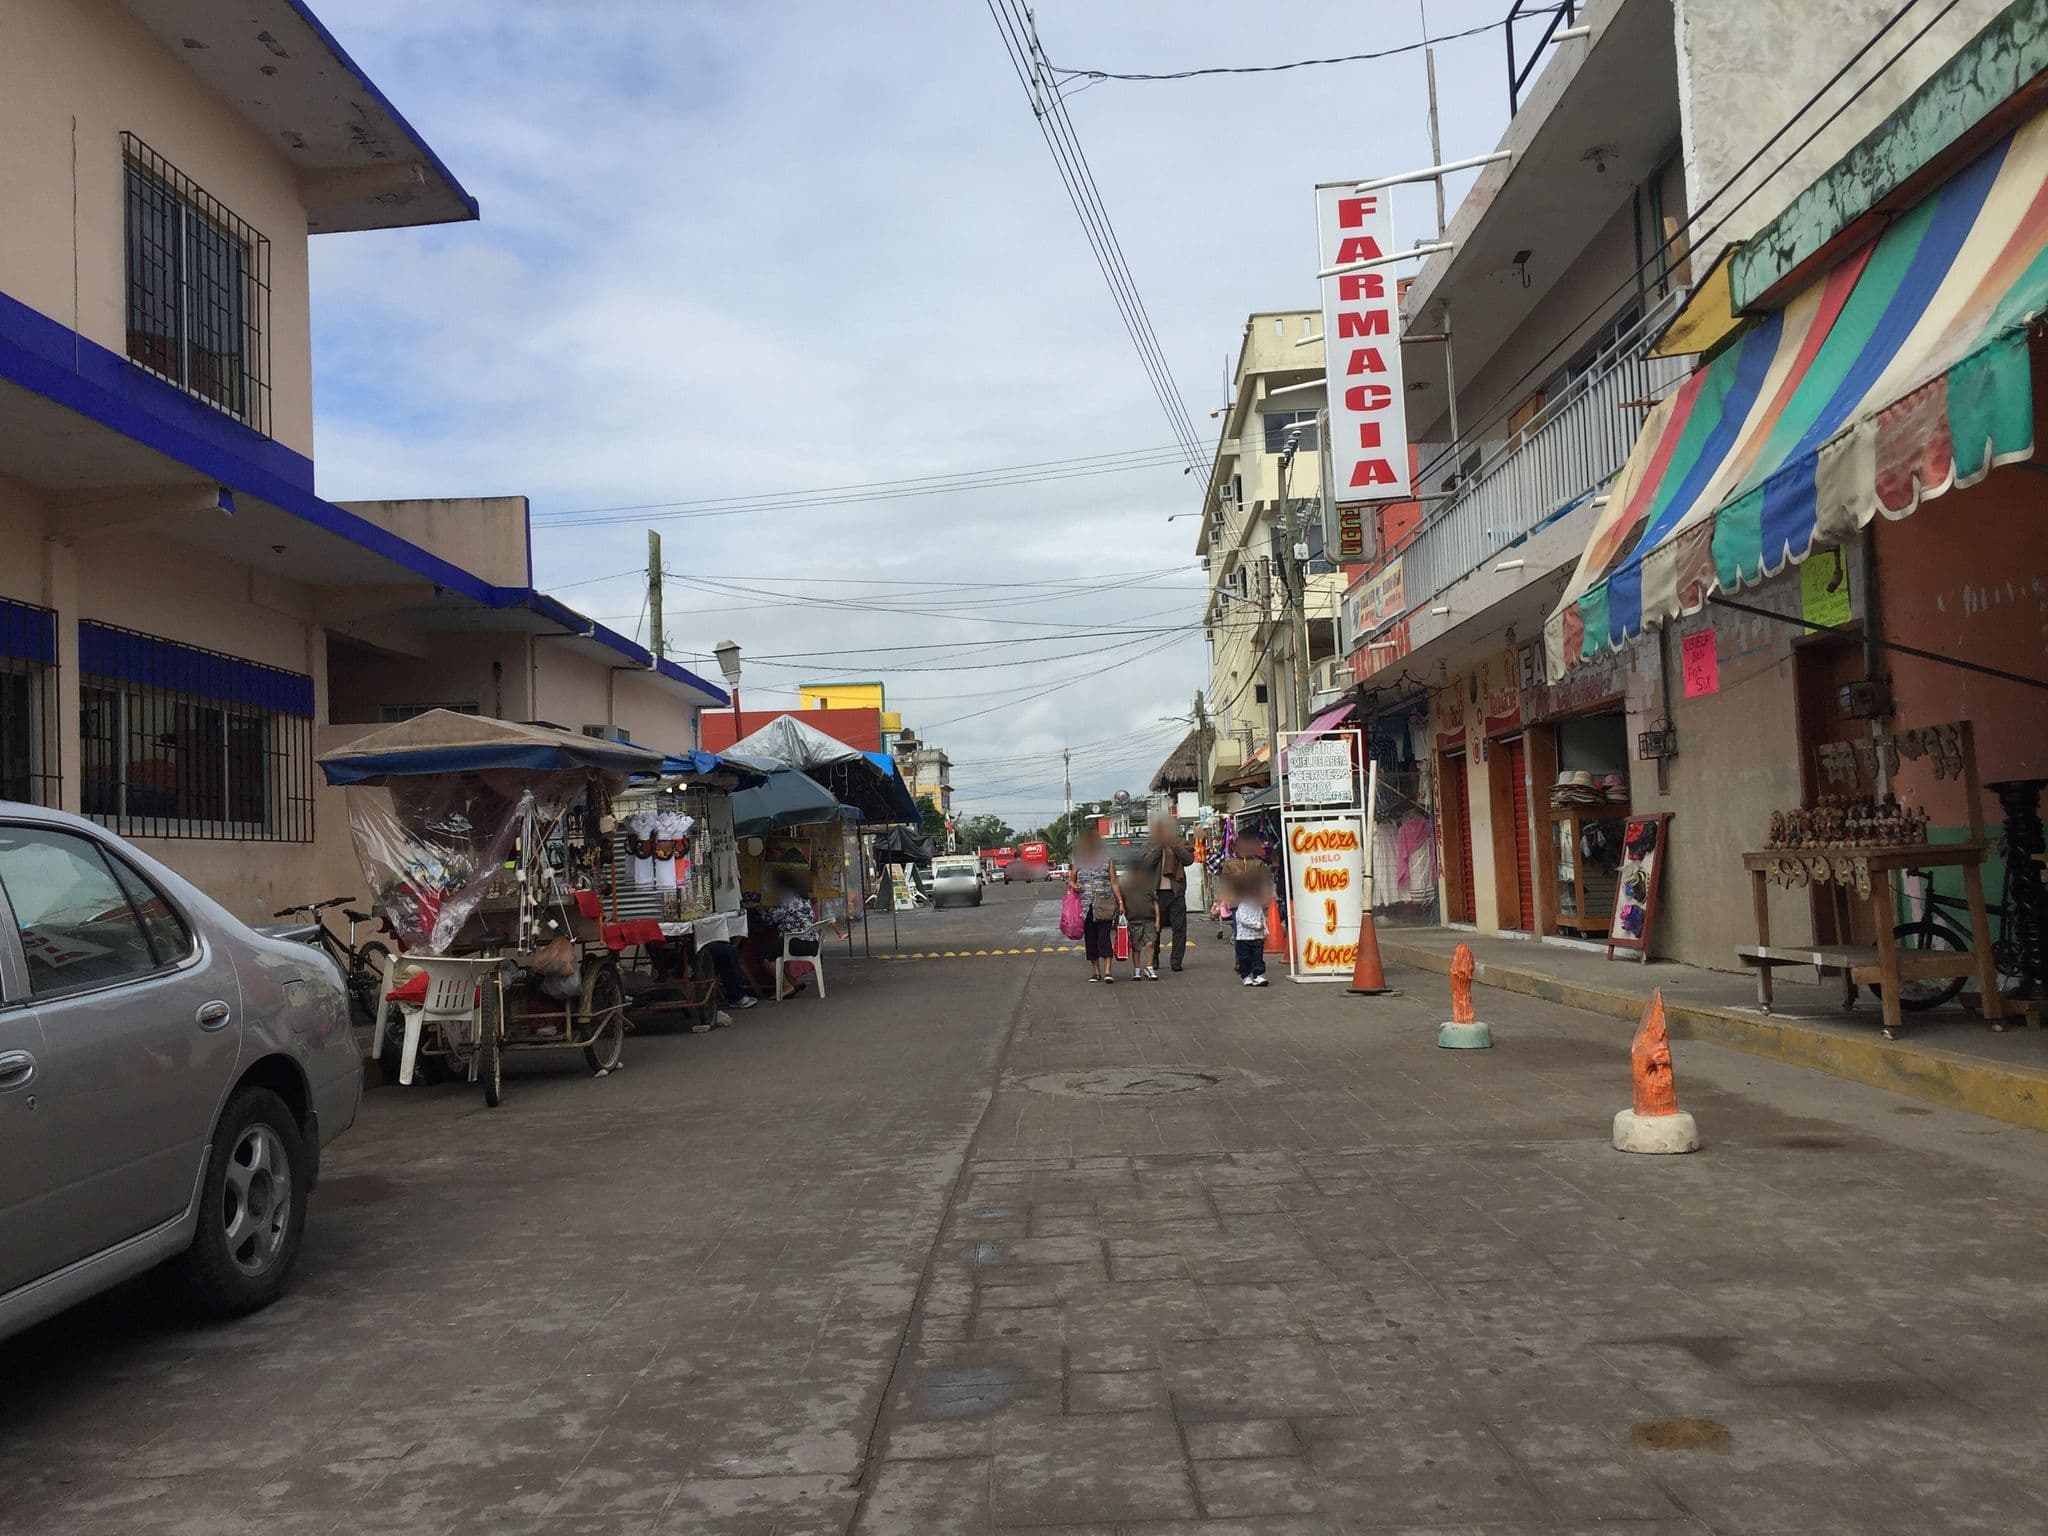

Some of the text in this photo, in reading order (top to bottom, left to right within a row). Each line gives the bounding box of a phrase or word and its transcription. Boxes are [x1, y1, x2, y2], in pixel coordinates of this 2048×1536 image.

[1336, 196, 1398, 487] FARMACIA
[1295, 742, 1350, 756] TORITOS
[1296, 781, 1332, 793] VINOS
[1292, 826, 1359, 855] Cerveza
[1310, 853, 1341, 864] HIELO
